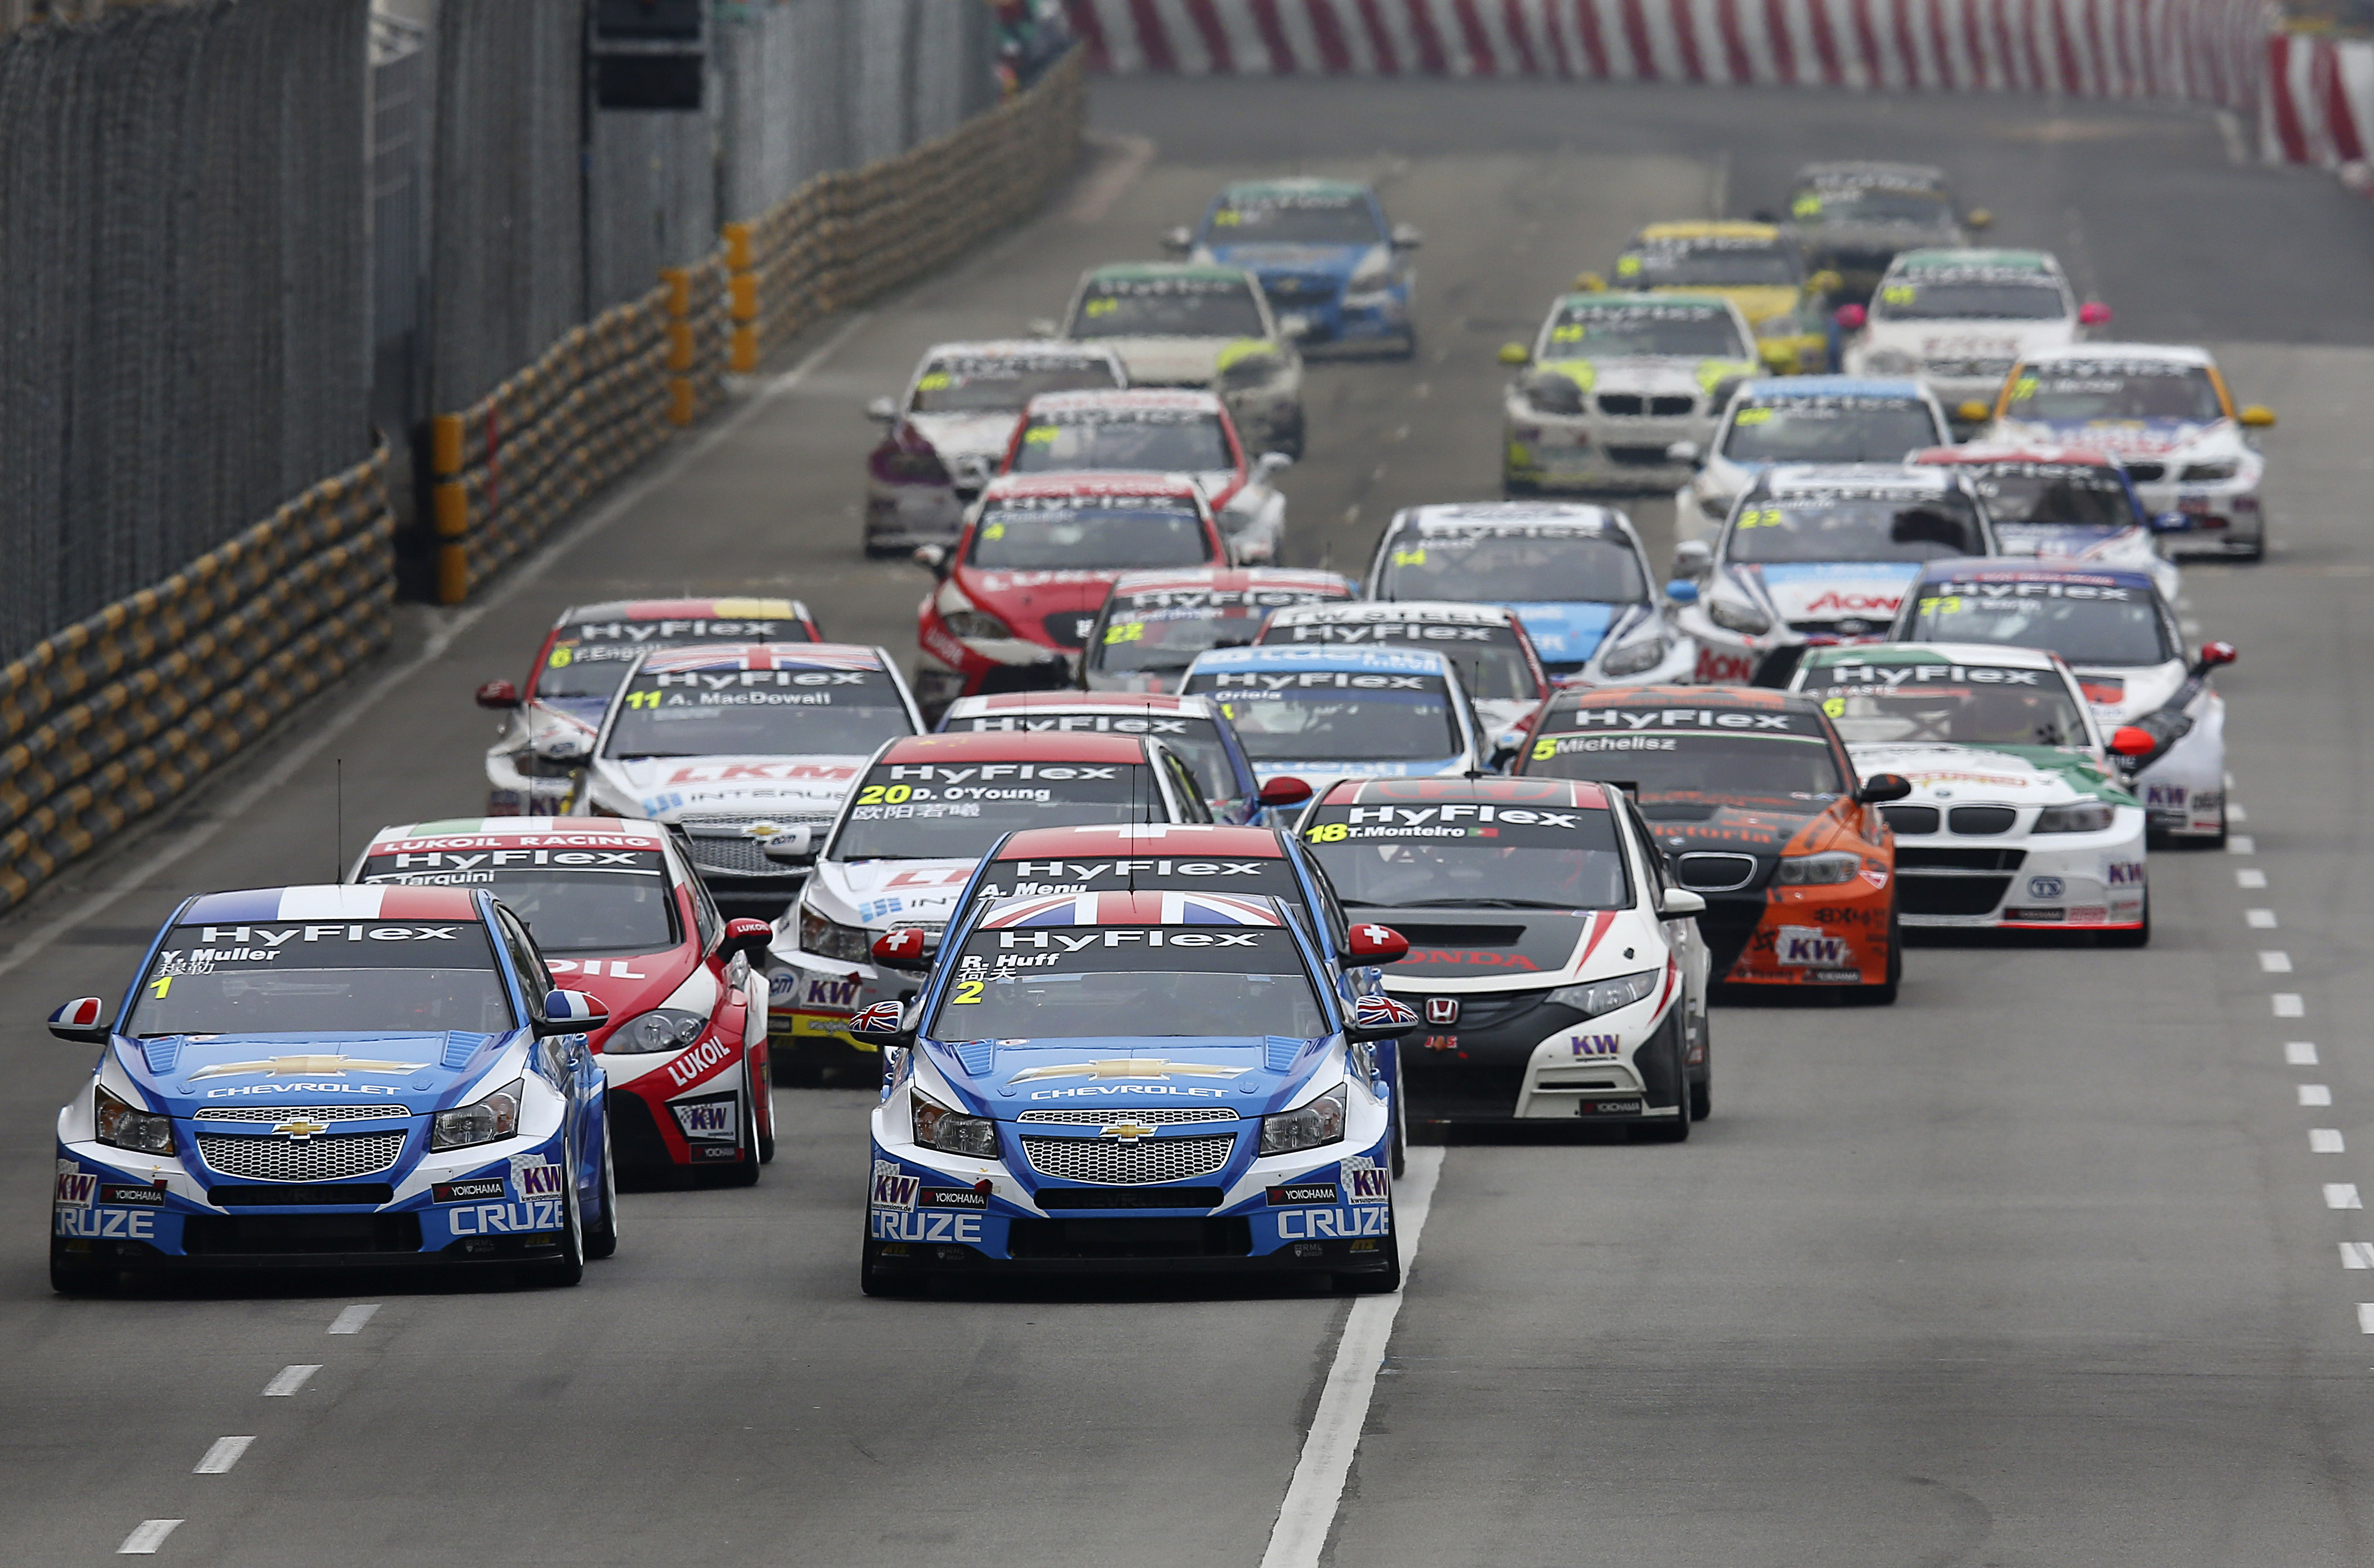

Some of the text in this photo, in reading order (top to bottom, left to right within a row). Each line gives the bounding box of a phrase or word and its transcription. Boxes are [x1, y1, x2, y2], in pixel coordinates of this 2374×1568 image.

[1736, 510, 1781, 529] 23
[1939, 582, 2130, 601] HyFlex
[581, 621, 777, 642] HyFlex
[1293, 623, 1491, 643] HyFlex
[656, 671, 866, 691] HyFlex
[1215, 672, 1424, 690] HyFlex
[1832, 665, 2038, 686] HyFlex
[625, 691, 832, 710] 11 A. MacDowall
[973, 716, 1186, 733] HyFlex
[1576, 709, 1790, 730] HyFlex
[1532, 736, 1677, 761] 5 Michelisz
[890, 764, 1116, 785] HyFlex
[856, 784, 1051, 805] 20 D. O'Young
[1349, 804, 1581, 829] HyFlex
[384, 836, 651, 852] LUKOIL RACING
[1305, 823, 1465, 844] 18 T.Monteiro
[396, 849, 637, 870] HyFlex
[1017, 860, 1262, 881] HyFlex
[978, 882, 1087, 898] A. Menu
[202, 924, 457, 947] HyFlex
[737, 923, 770, 933] LUKOIL
[999, 930, 1259, 952] HyFlex
[1789, 939, 1842, 960] KW
[161, 947, 280, 963] Y. Muller
[962, 952, 1060, 967] R. Huff
[1390, 950, 1541, 970] ONDA
[957, 966, 1017, 982] 荷夫
[149, 977, 174, 999] 1
[807, 980, 861, 1004] KW
[952, 981, 985, 1004] 2
[1571, 1034, 1620, 1056] KW
[668, 1035, 731, 1088] LUKOIL
[207, 1083, 402, 1098] CHEVROLET
[1030, 1085, 1229, 1099] CHEVROLET
[691, 1106, 727, 1131] KW
[57, 1173, 95, 1202] KW
[451, 1183, 502, 1196] YOKOHAMA
[523, 1166, 561, 1194] KW
[874, 1175, 918, 1205] KW
[1353, 1170, 1388, 1197] KW
[115, 1190, 162, 1201] YOKOHAMA
[935, 1192, 985, 1205] YOKOHAMA
[1285, 1188, 1335, 1200] YOKOHAMA
